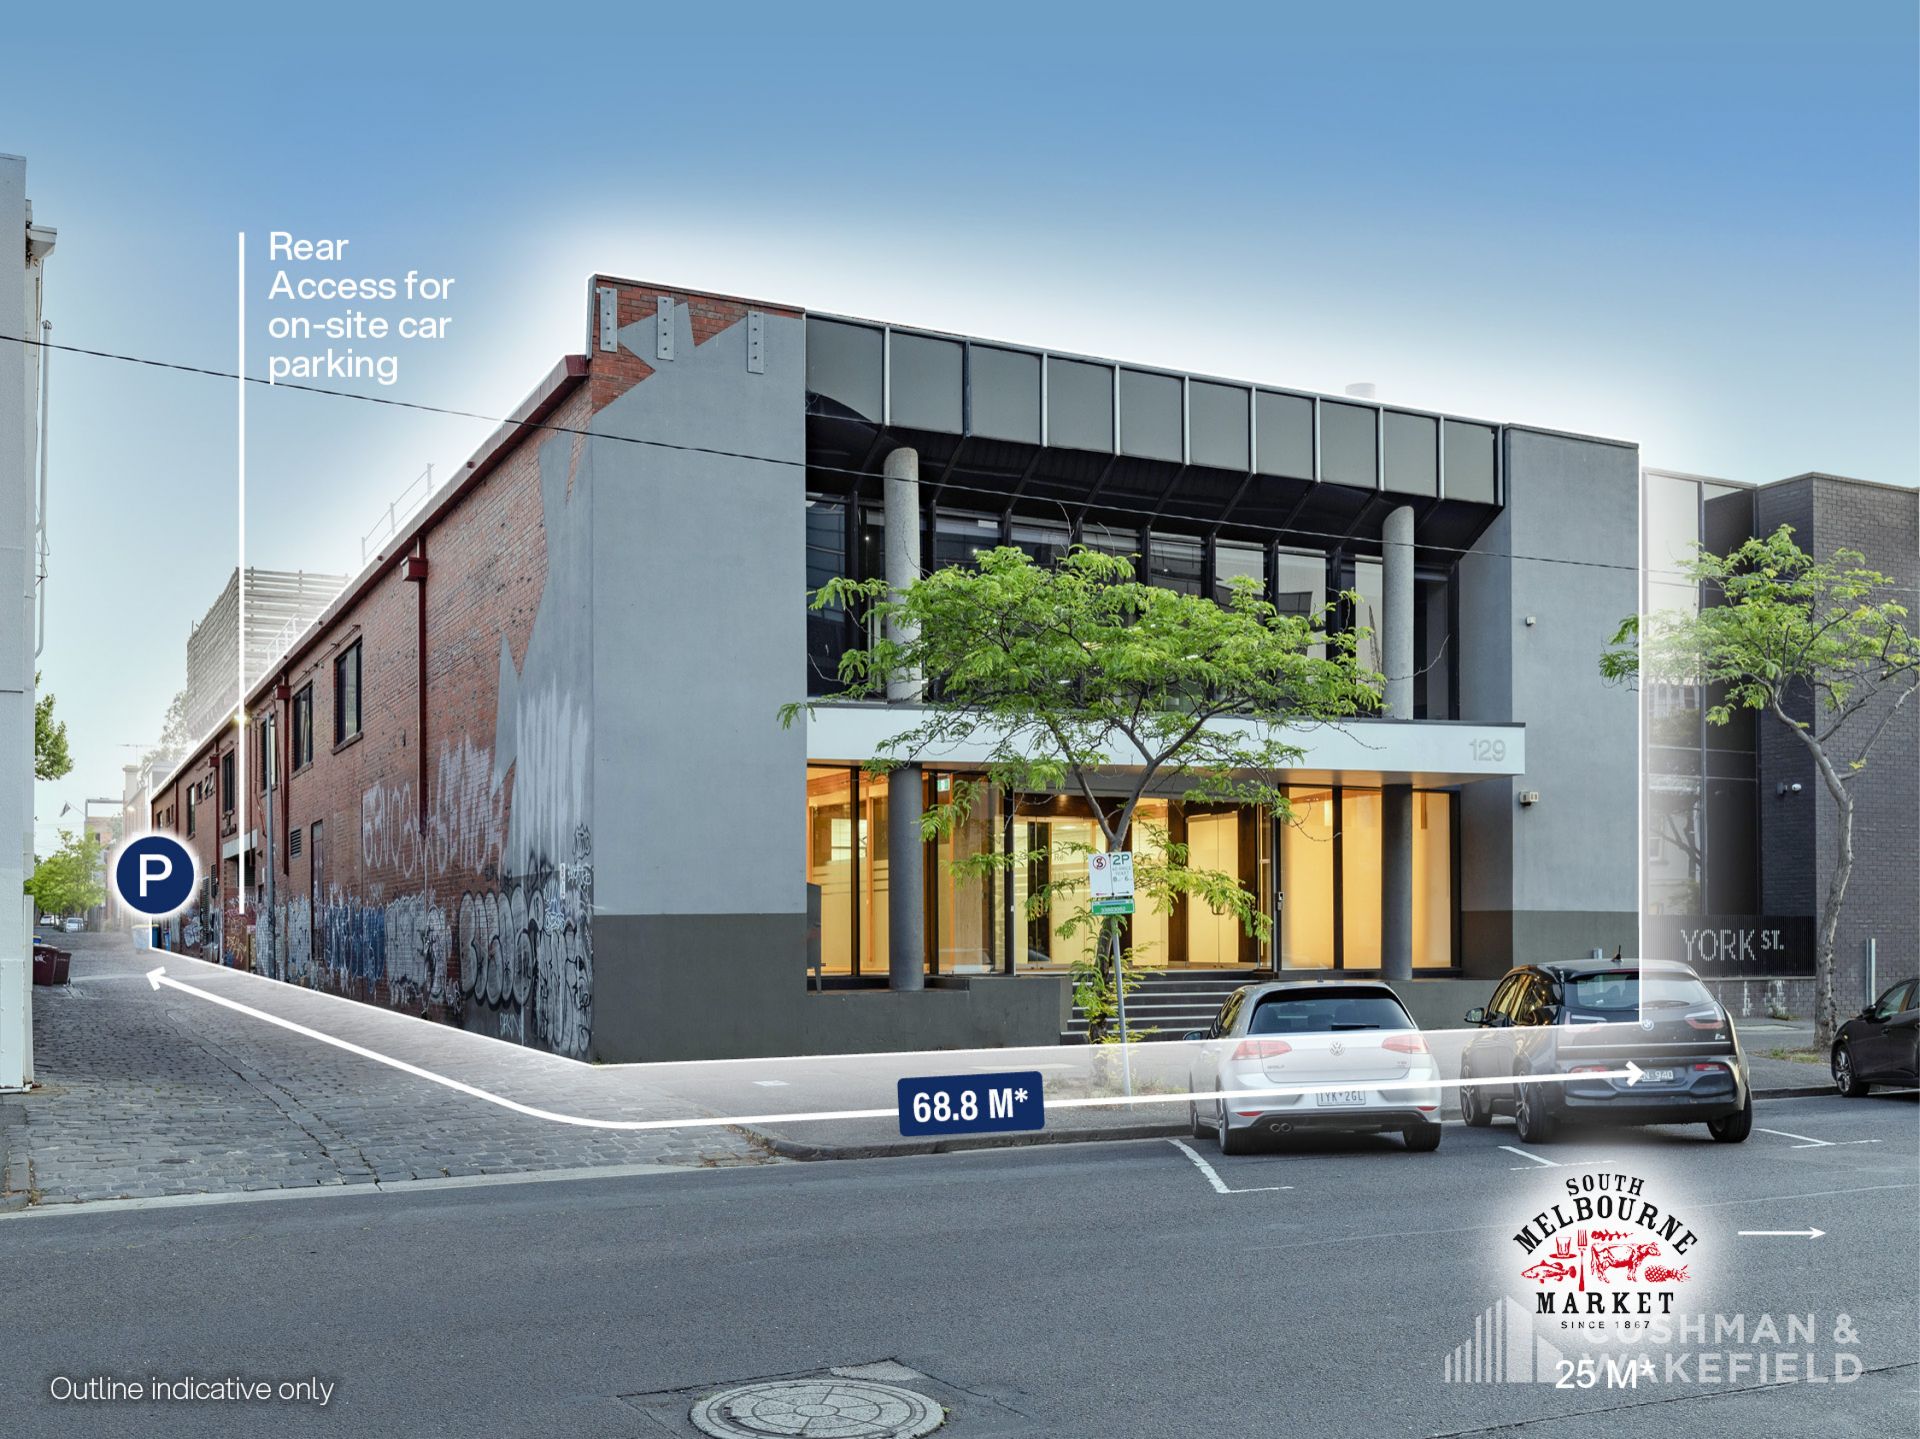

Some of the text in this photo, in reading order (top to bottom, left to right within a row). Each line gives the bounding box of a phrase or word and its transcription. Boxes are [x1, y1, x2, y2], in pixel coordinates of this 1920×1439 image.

[1469, 739, 1506, 762] 129
[1112, 854, 1130, 866] 2P
[1680, 929, 1785, 961] YORK ST.
